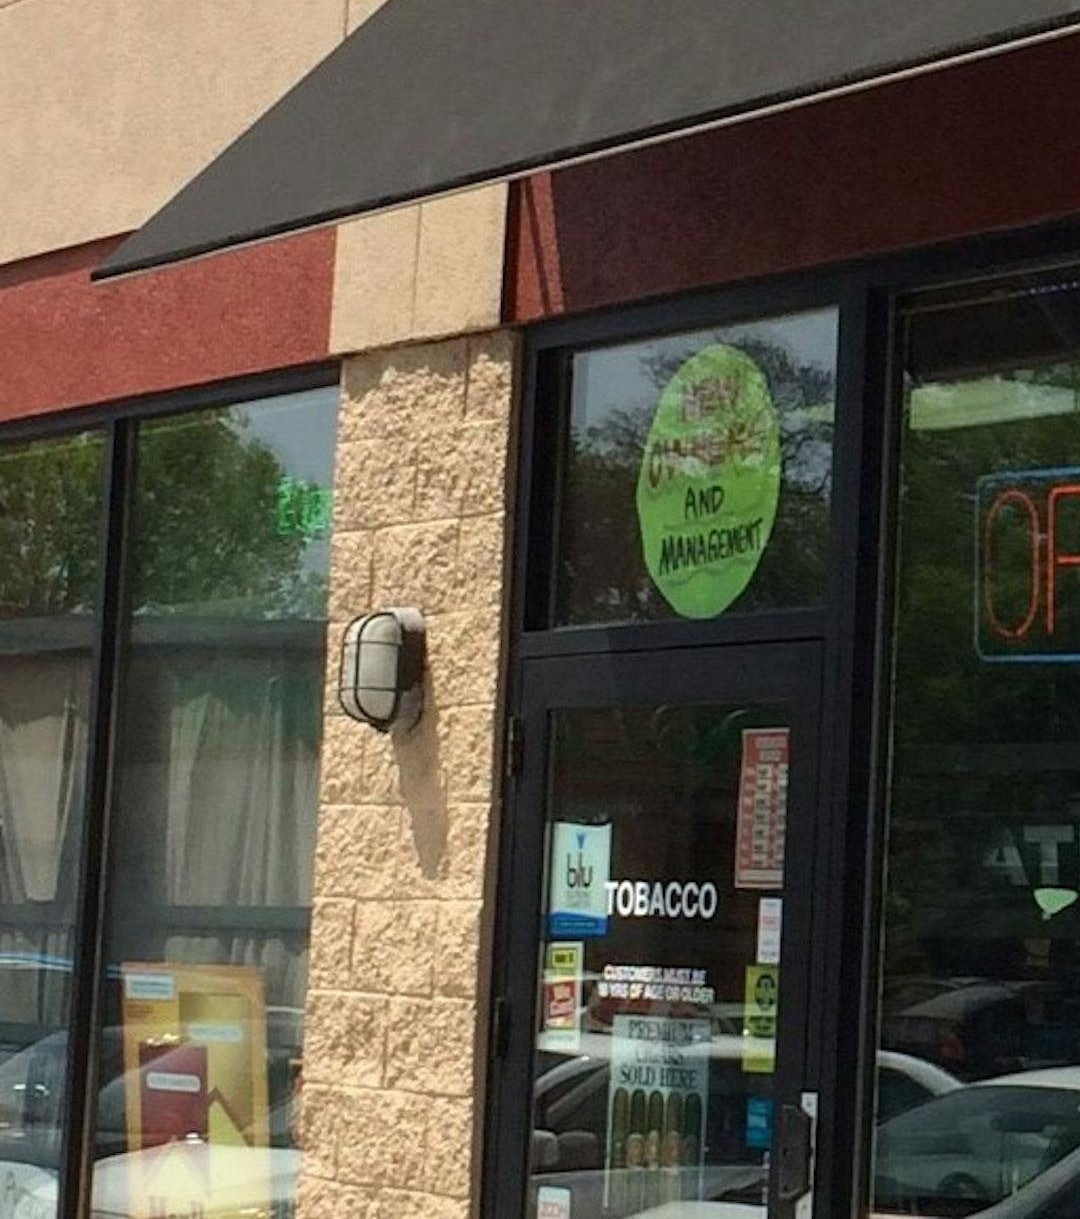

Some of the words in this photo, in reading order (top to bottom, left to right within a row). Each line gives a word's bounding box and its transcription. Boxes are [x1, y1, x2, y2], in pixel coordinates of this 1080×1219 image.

[684, 485, 725, 519] AND
[658, 517, 764, 577] MANAGEMENT
[603, 879, 719, 919] TOBACCO
[629, 983, 643, 1000] OF
[619, 1063, 657, 1086] SOLD
[659, 1065, 699, 1089] HERE
